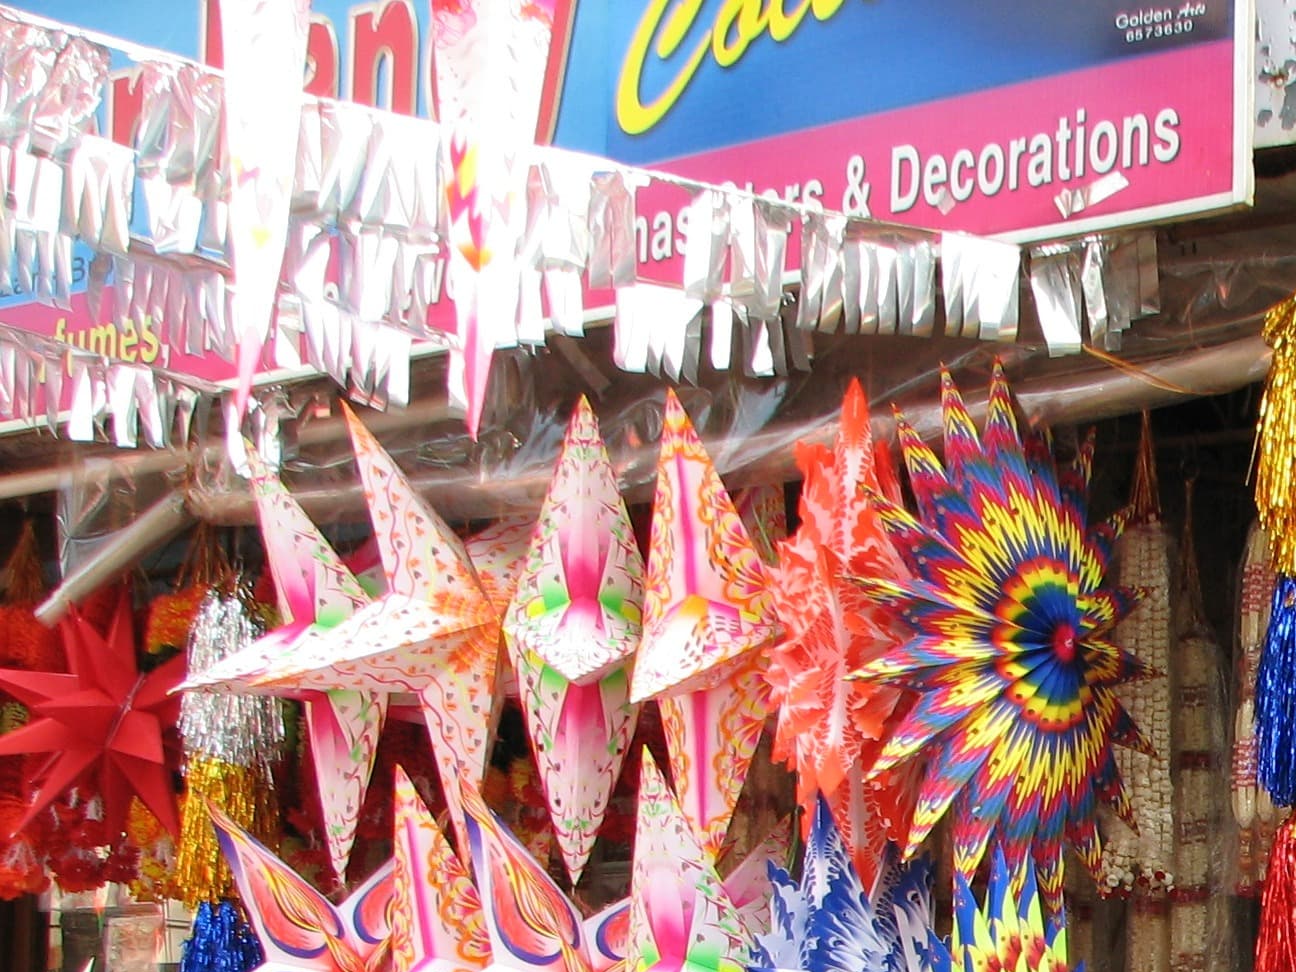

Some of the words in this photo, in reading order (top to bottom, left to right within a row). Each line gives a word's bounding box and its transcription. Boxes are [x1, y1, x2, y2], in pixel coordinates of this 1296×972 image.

[1115, 8, 1173, 29] Golden
[1125, 19, 1193, 43] 6573630
[841, 155, 872, 216] &
[890, 106, 1181, 214] Decorations
